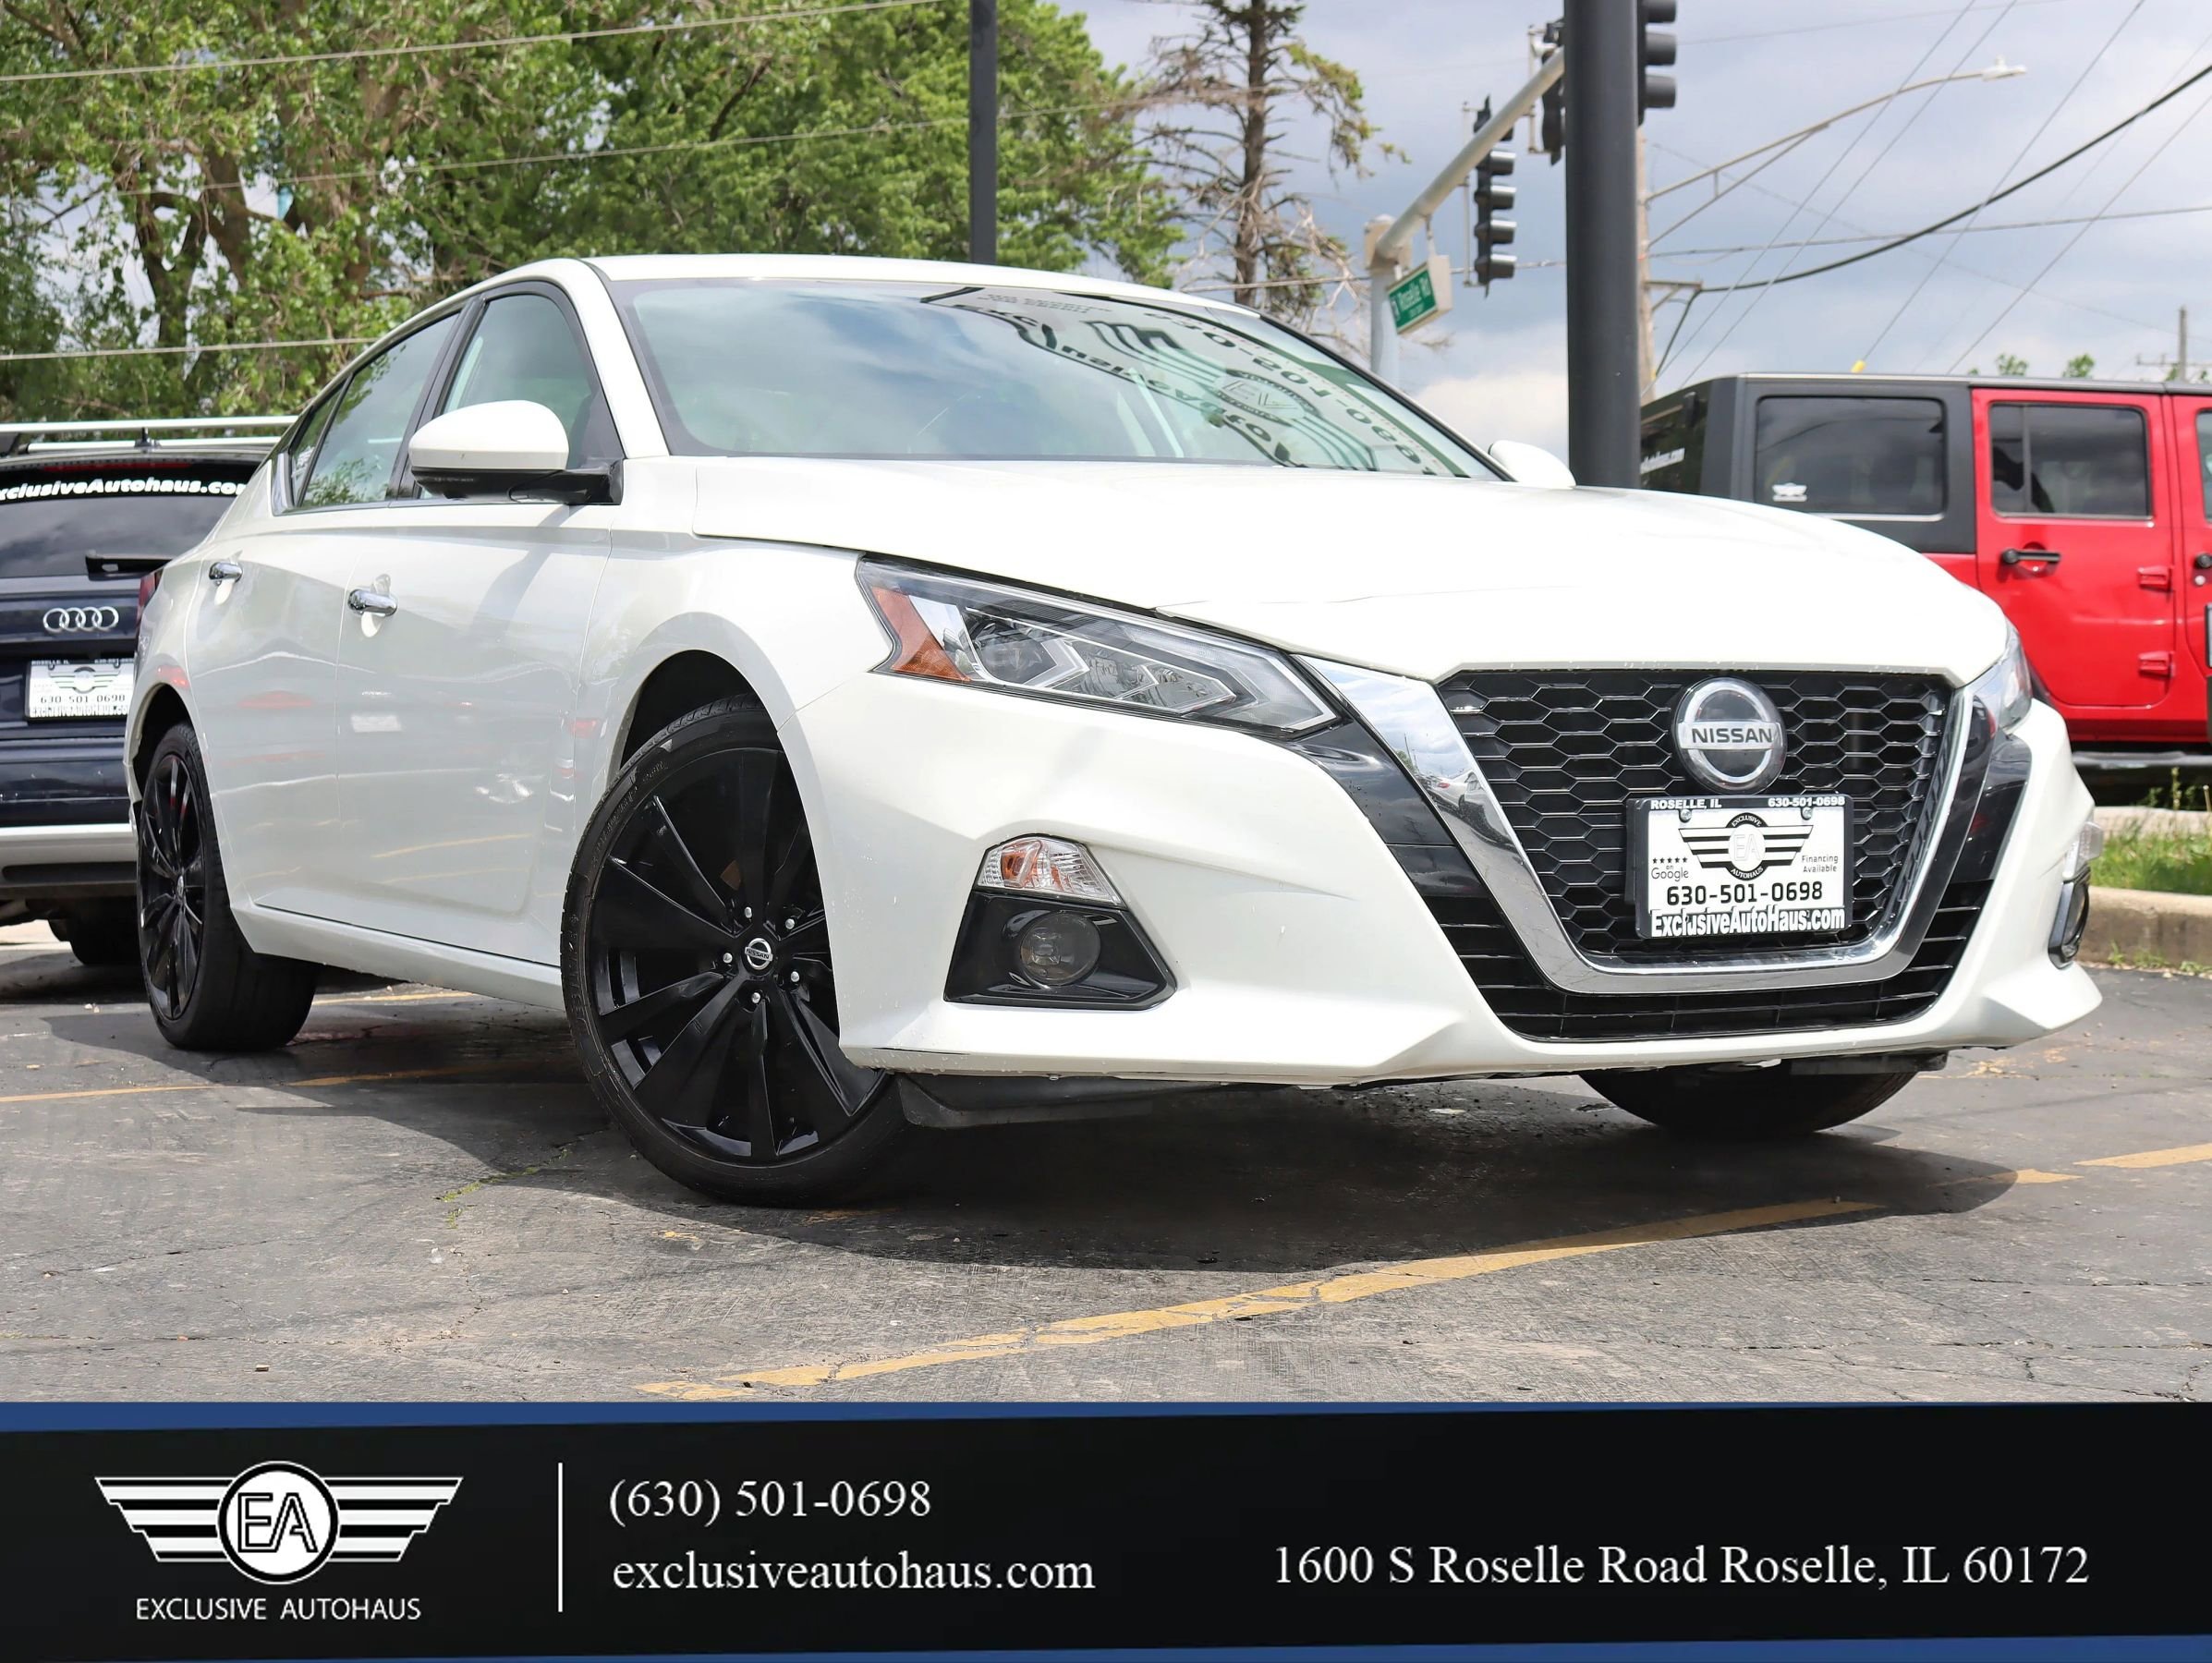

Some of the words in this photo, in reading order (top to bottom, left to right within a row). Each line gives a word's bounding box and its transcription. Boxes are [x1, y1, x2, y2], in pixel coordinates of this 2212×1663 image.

[1692, 727, 1773, 744] NISSAN
[1650, 799, 1708, 810] ROSELLE,
[1709, 798, 1722, 809] IL
[1768, 795, 1846, 807] 630-501-0698
[1731, 814, 1762, 828] EXCLUSIVE
[1801, 855, 1839, 865] Financing
[1651, 867, 1689, 882] Google
[1731, 866, 1764, 880] AUTOHAUS
[1803, 865, 1838, 874] Available
[1666, 880, 1823, 906] 630-501-0698
[1650, 905, 1845, 937] ExclusiveAutoHaus.com
[746, 948, 770, 960] NISSAN
